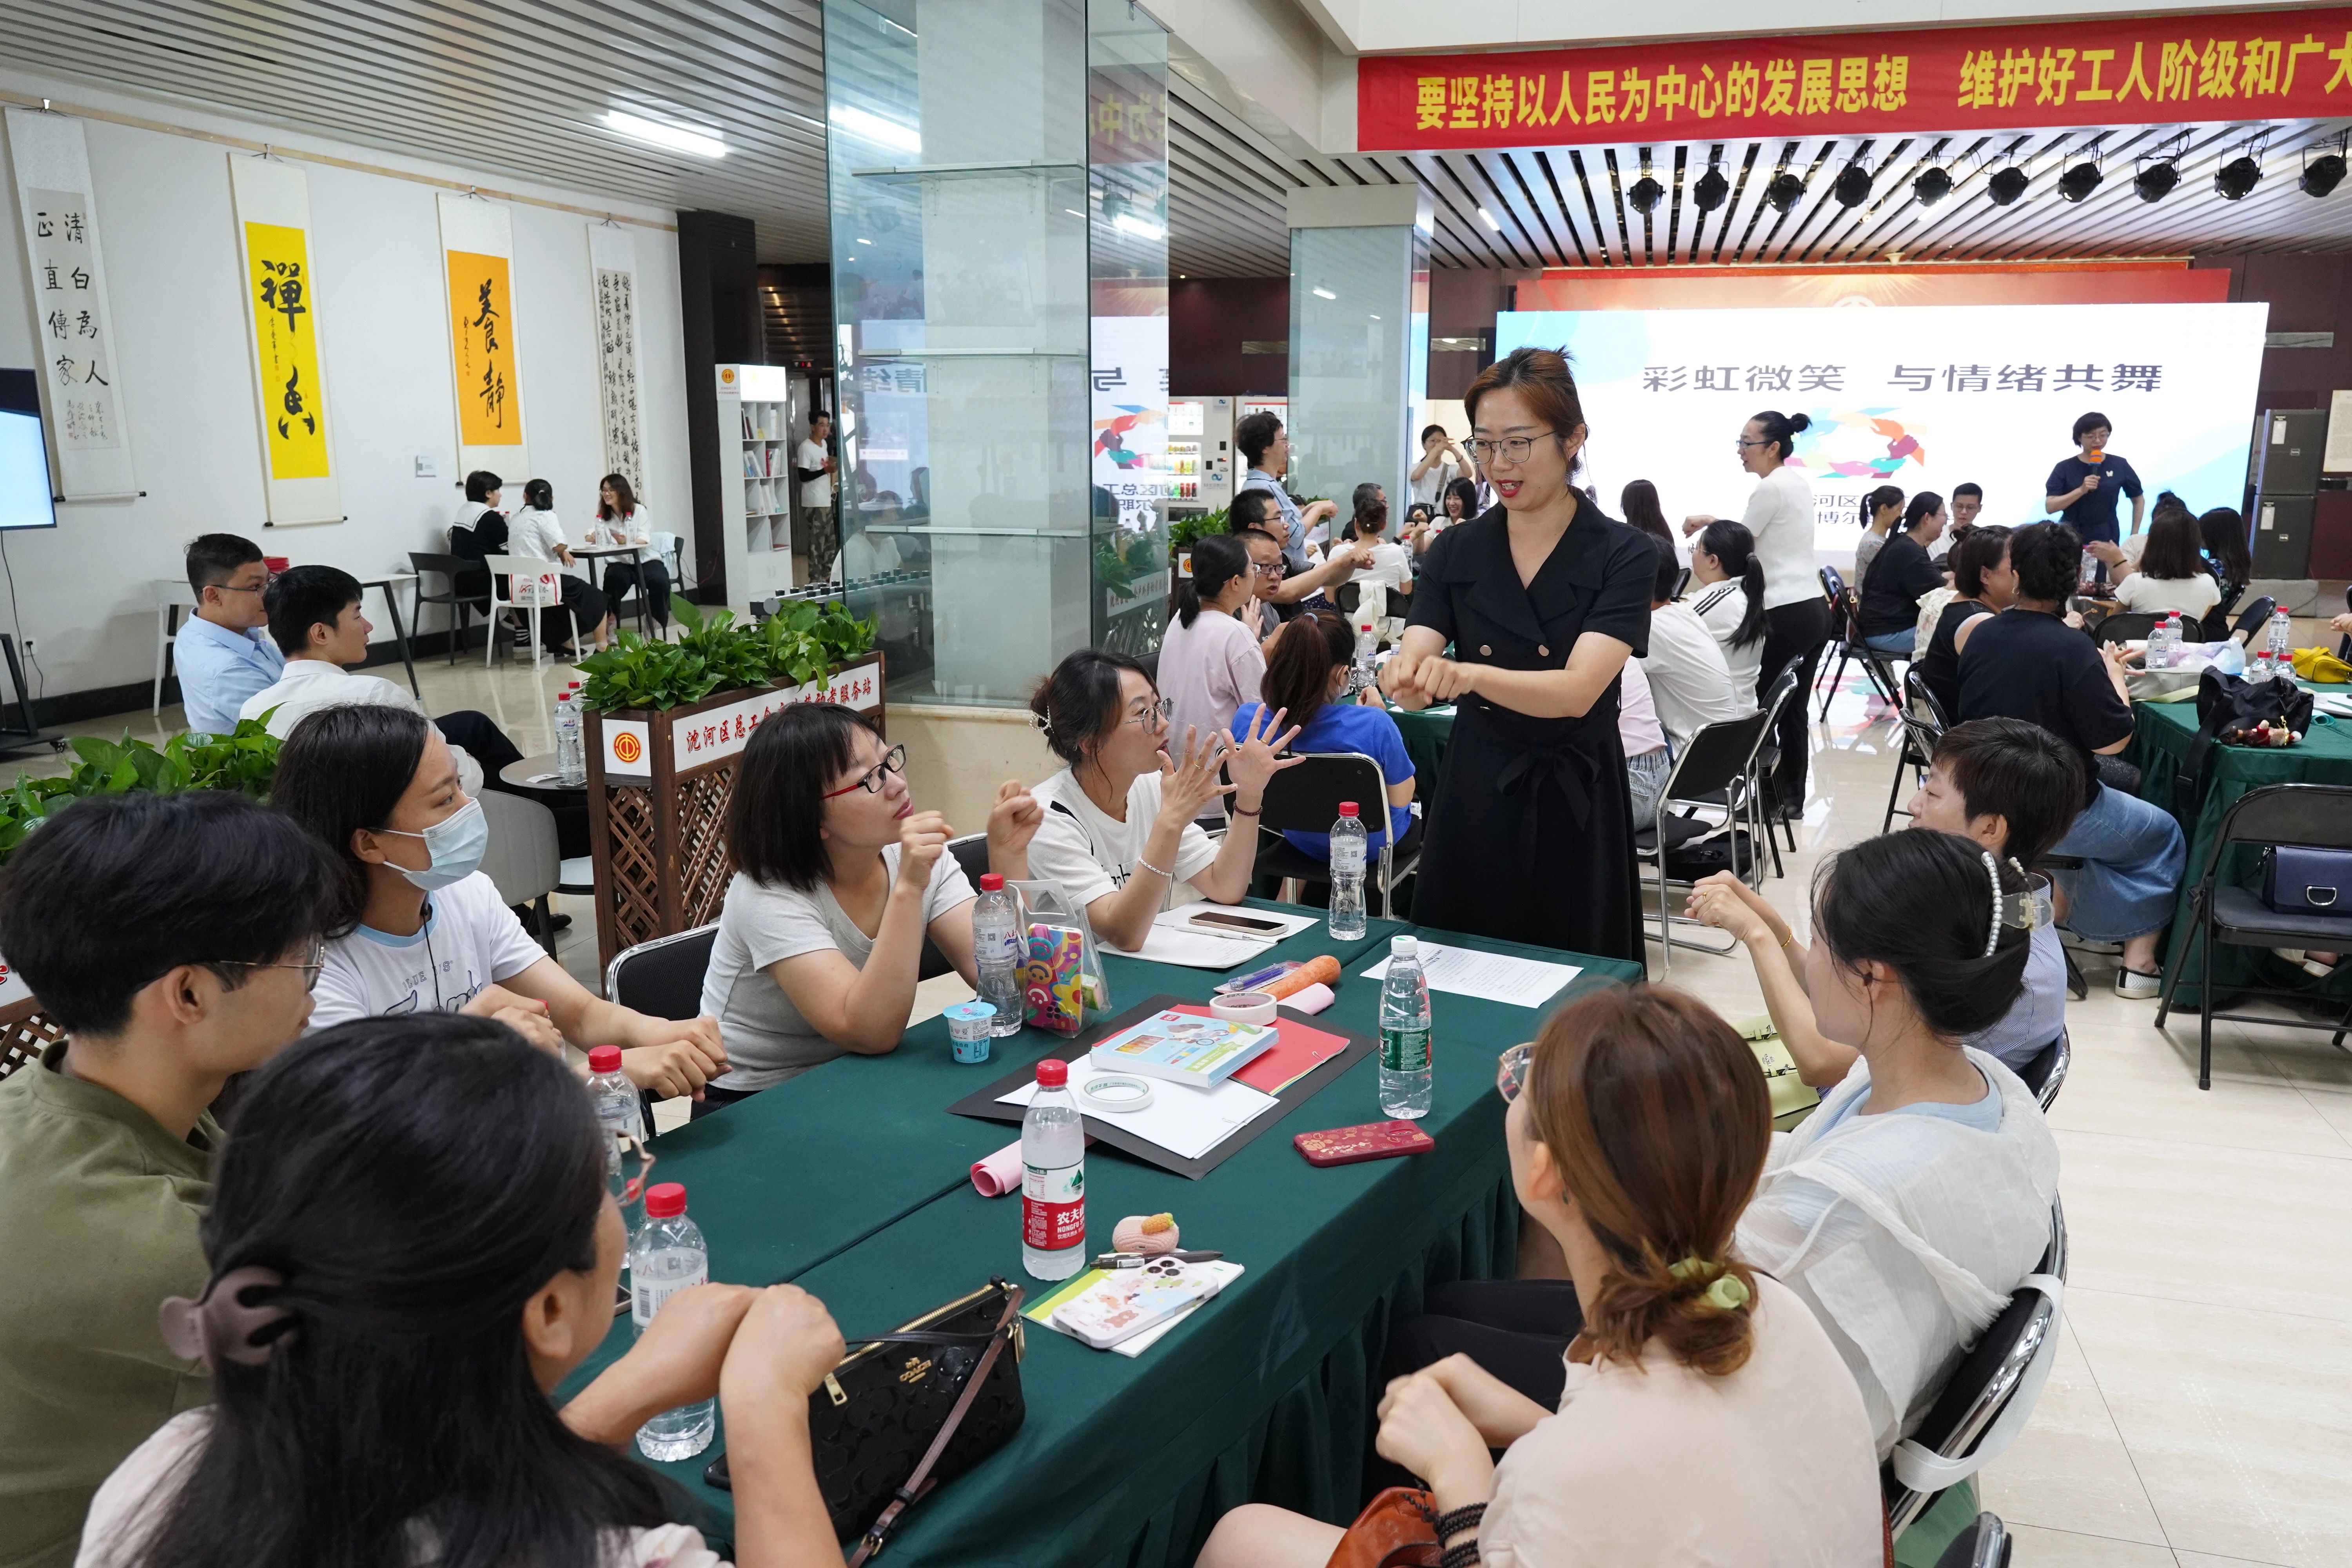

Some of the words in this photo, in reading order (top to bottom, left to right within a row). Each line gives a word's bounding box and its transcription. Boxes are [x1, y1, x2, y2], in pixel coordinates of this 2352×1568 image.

[1416, 54, 1908, 130] 要坚持以人民为中心的发展思想
[1958, 31, 2352, 109] 维护好工人阶级和广大
[1642, 365, 1846, 392] 彩虹微笑
[1887, 363, 2163, 392] 与情绪共舞
[1057, 1222, 1079, 1233] NONGFU
